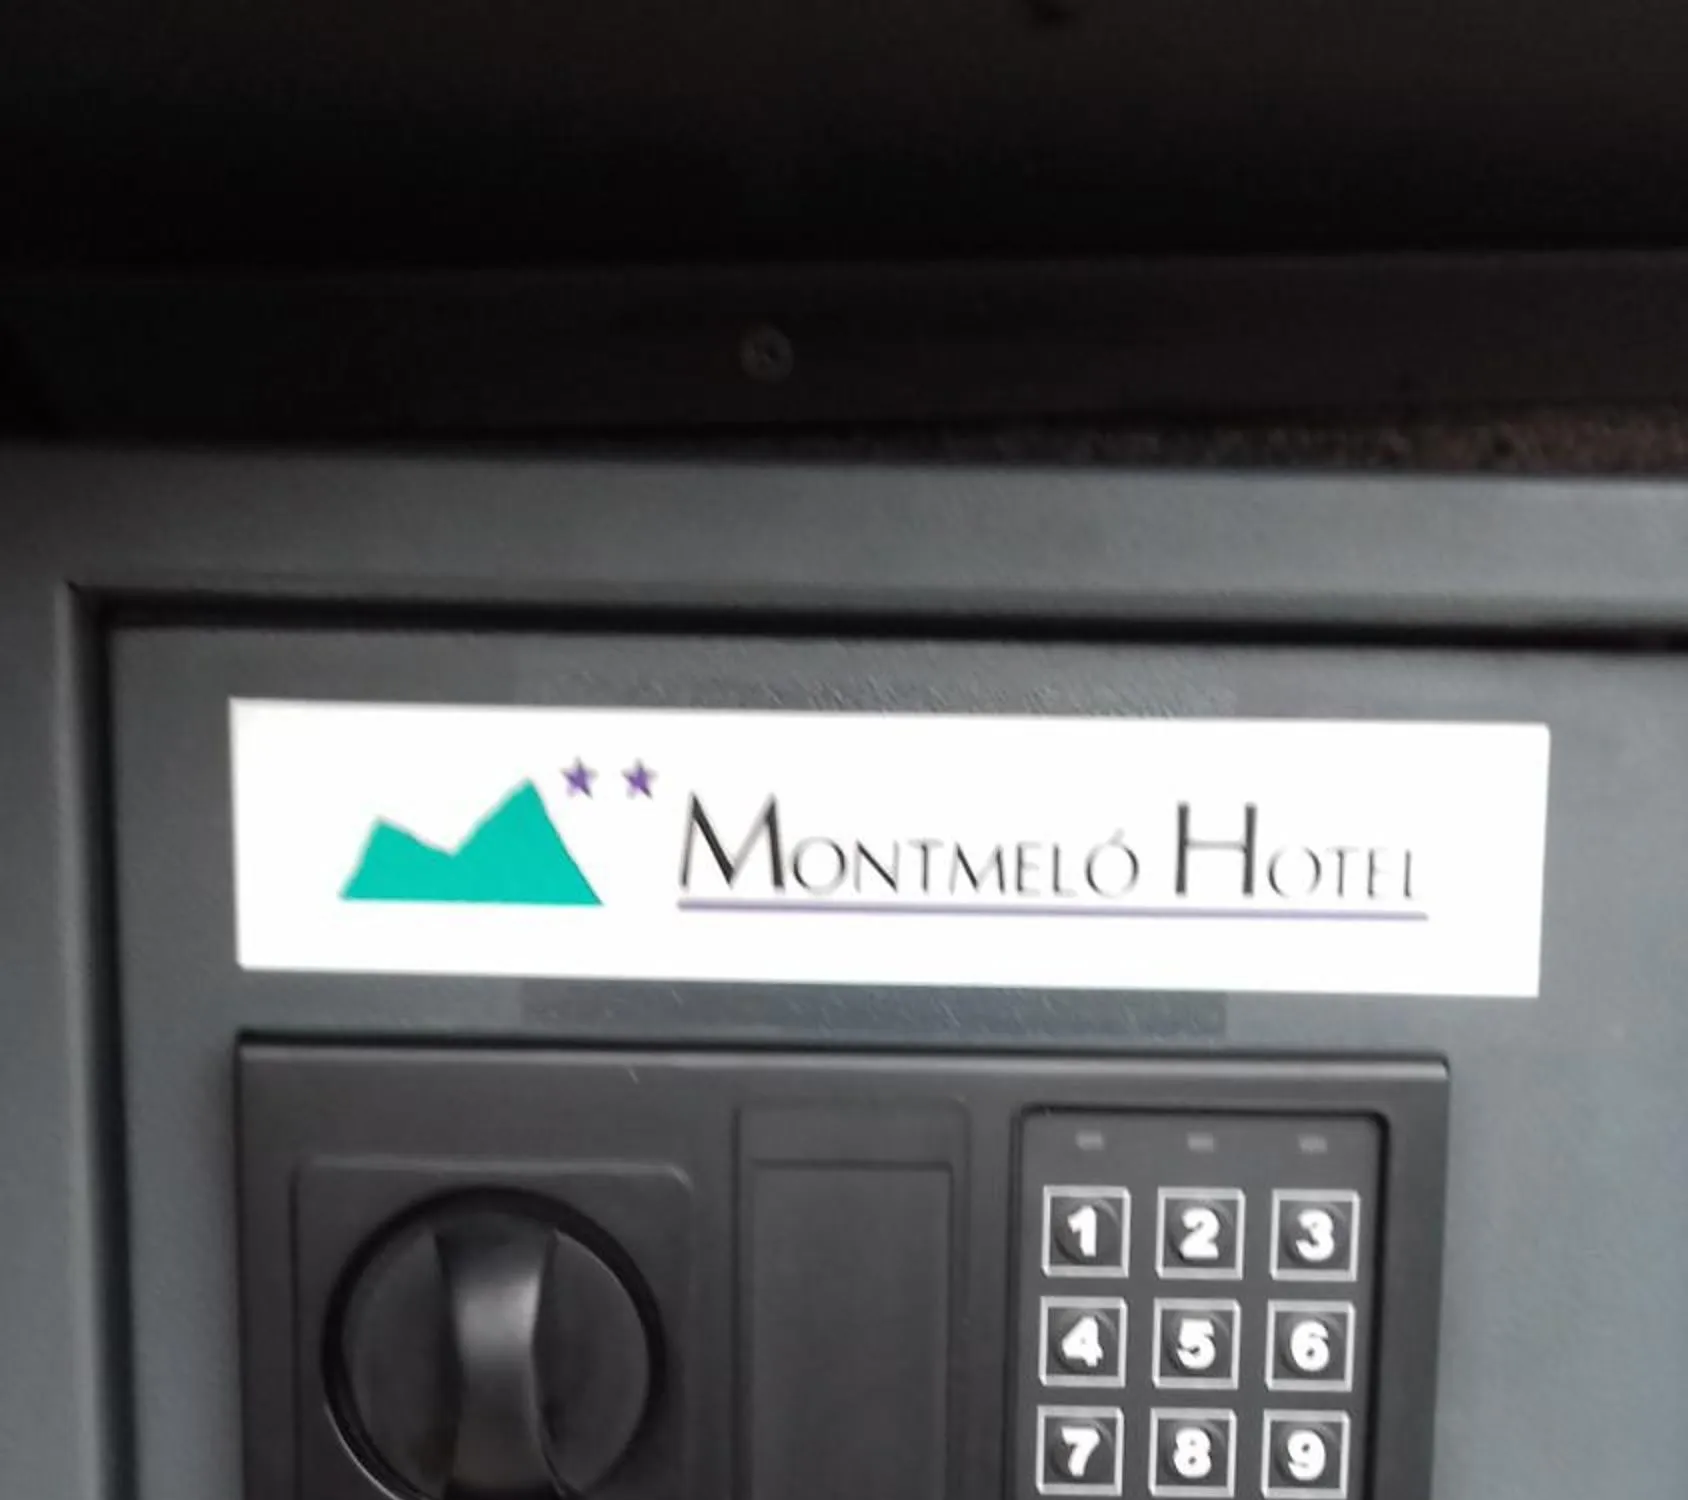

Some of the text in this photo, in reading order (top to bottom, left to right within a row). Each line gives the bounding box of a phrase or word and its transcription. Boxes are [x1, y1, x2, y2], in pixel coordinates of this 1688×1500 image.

[1173, 802, 1420, 900] HOTEL
[1067, 1205, 1335, 1262] 1 2 3
[1061, 1316, 1329, 1372] 4 5 6
[1061, 1427, 1326, 1481] 7 8 9
